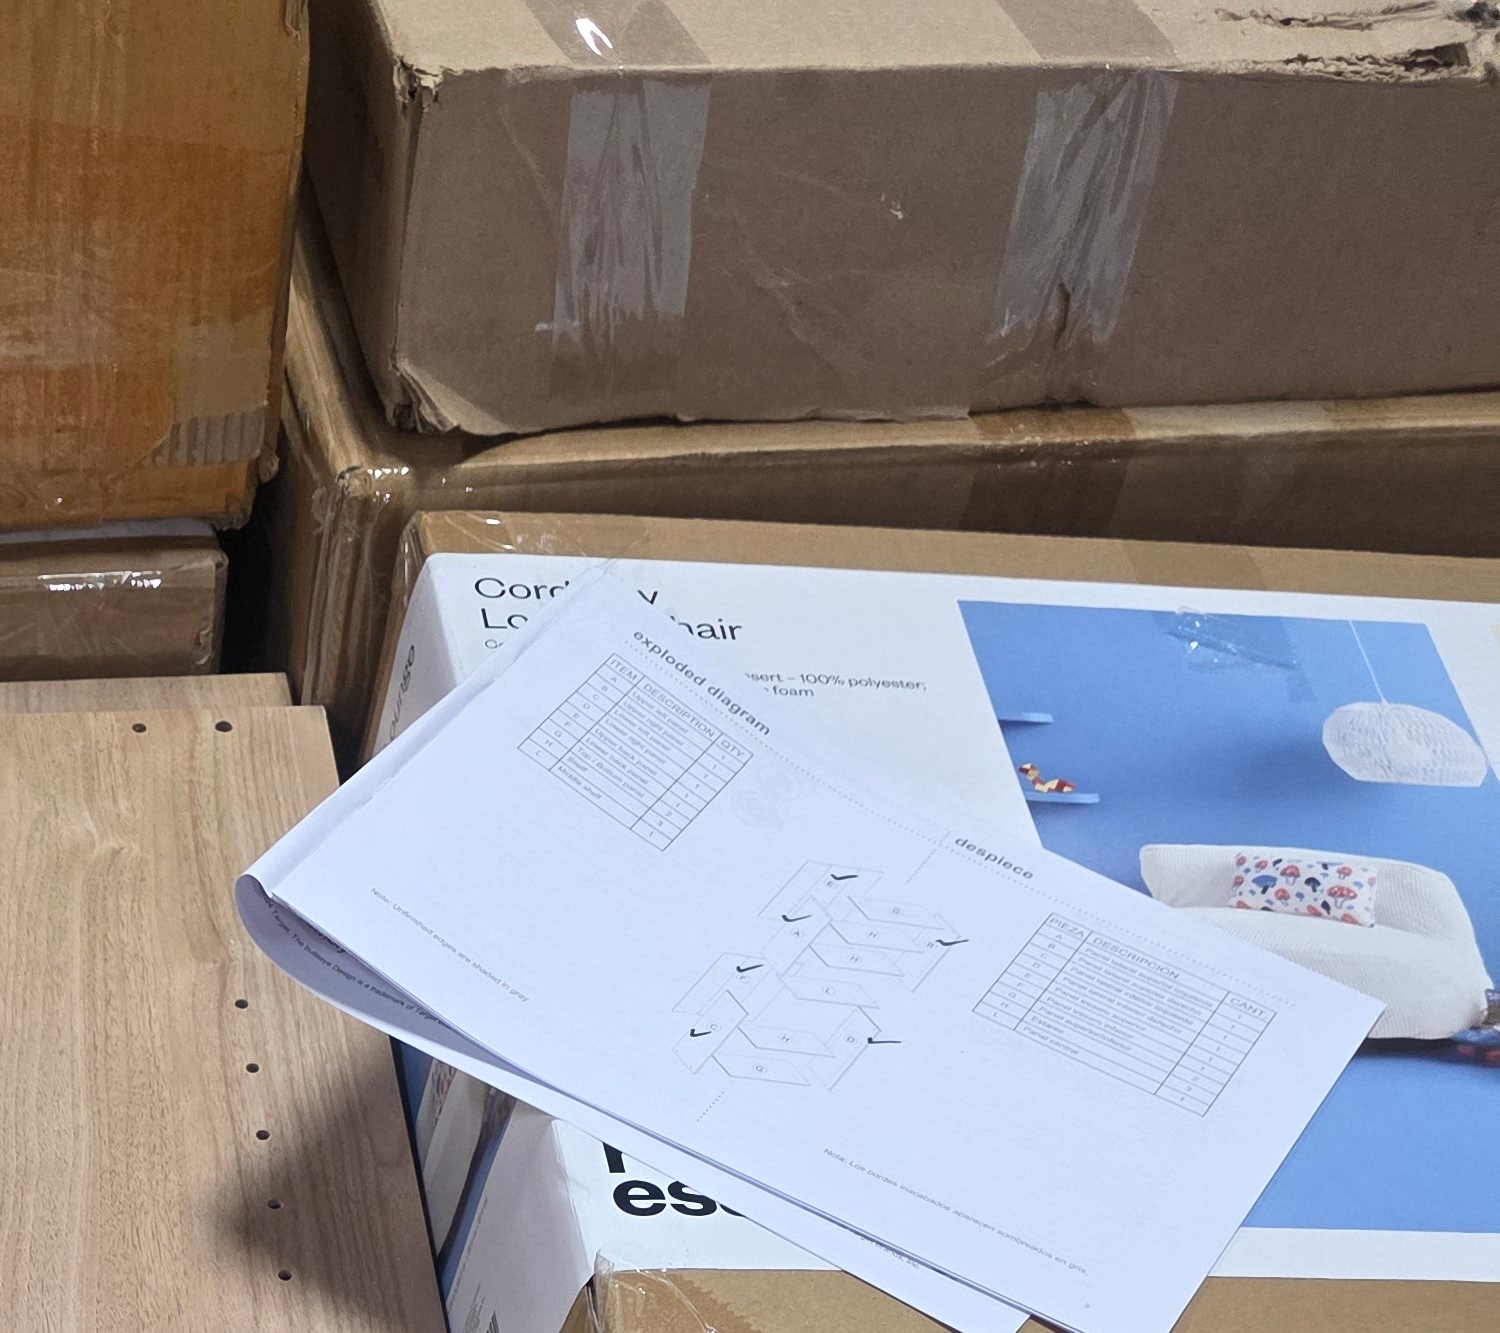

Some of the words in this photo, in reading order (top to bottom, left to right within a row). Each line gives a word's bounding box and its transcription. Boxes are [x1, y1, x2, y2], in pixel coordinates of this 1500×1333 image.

[633, 631, 707, 687] exploded
[707, 683, 770, 735] diagram
[800, 673, 844, 686] 100%
[609, 659, 637, 680] ITEM
[642, 683, 715, 737] DESCRIPTION
[720, 739, 744, 758] QTY
[955, 836, 1034, 880] despiece
[1048, 917, 1086, 937] PIEZA
